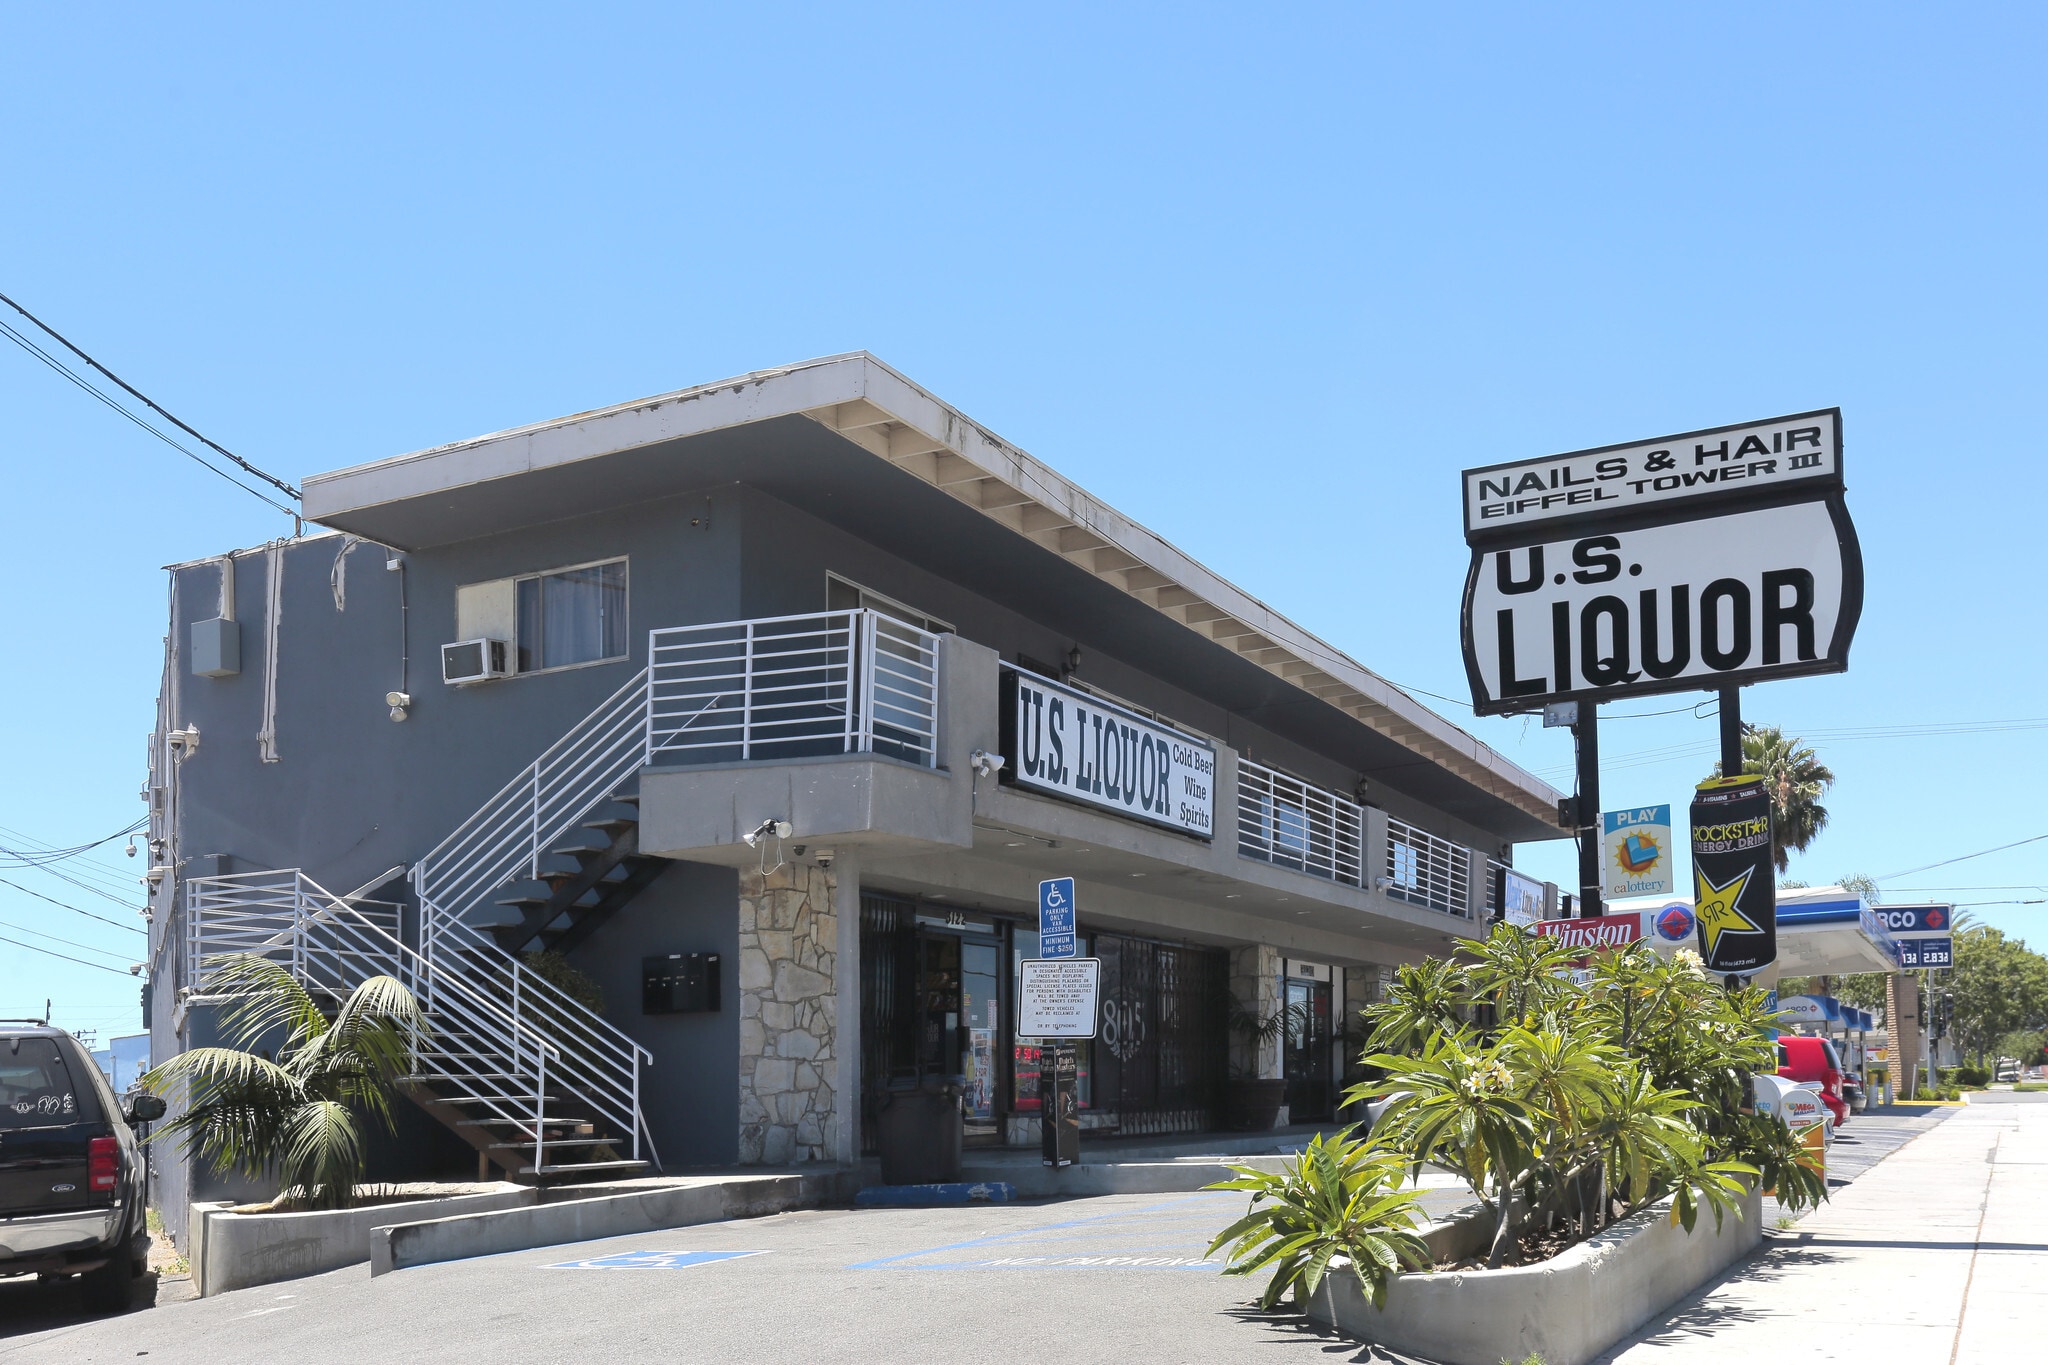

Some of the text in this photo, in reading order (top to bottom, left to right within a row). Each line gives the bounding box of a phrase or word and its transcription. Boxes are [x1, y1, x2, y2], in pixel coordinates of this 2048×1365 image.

[1480, 426, 1822, 501] NAILS & HAIR
[1480, 452, 1823, 519] EIFFEL TOWER III
[1496, 535, 1643, 596] U.S.
[1496, 567, 1818, 699] LIQUOR
[1020, 685, 1171, 817] U.S. LIQUOR
[1172, 743, 1213, 776] Cold Beer
[1183, 775, 1207, 801] Wine
[1179, 803, 1210, 829] Spirits
[1617, 808, 1658, 825] PLAY
[1693, 832, 1770, 852] ENERGY DRINK
[1613, 880, 1665, 894] calottery
[1045, 907, 1069, 916] PARKING
[1875, 911, 1916, 928] RCO
[1042, 925, 1073, 934] ACCESSIBLE
[1545, 922, 1632, 951] Winston
[1042, 945, 1055, 954] FINE
[1045, 936, 1070, 945] MINIMUM
[1795, 1103, 1815, 1111] MEGA
[1049, 1256, 1220, 1266] PARKING
